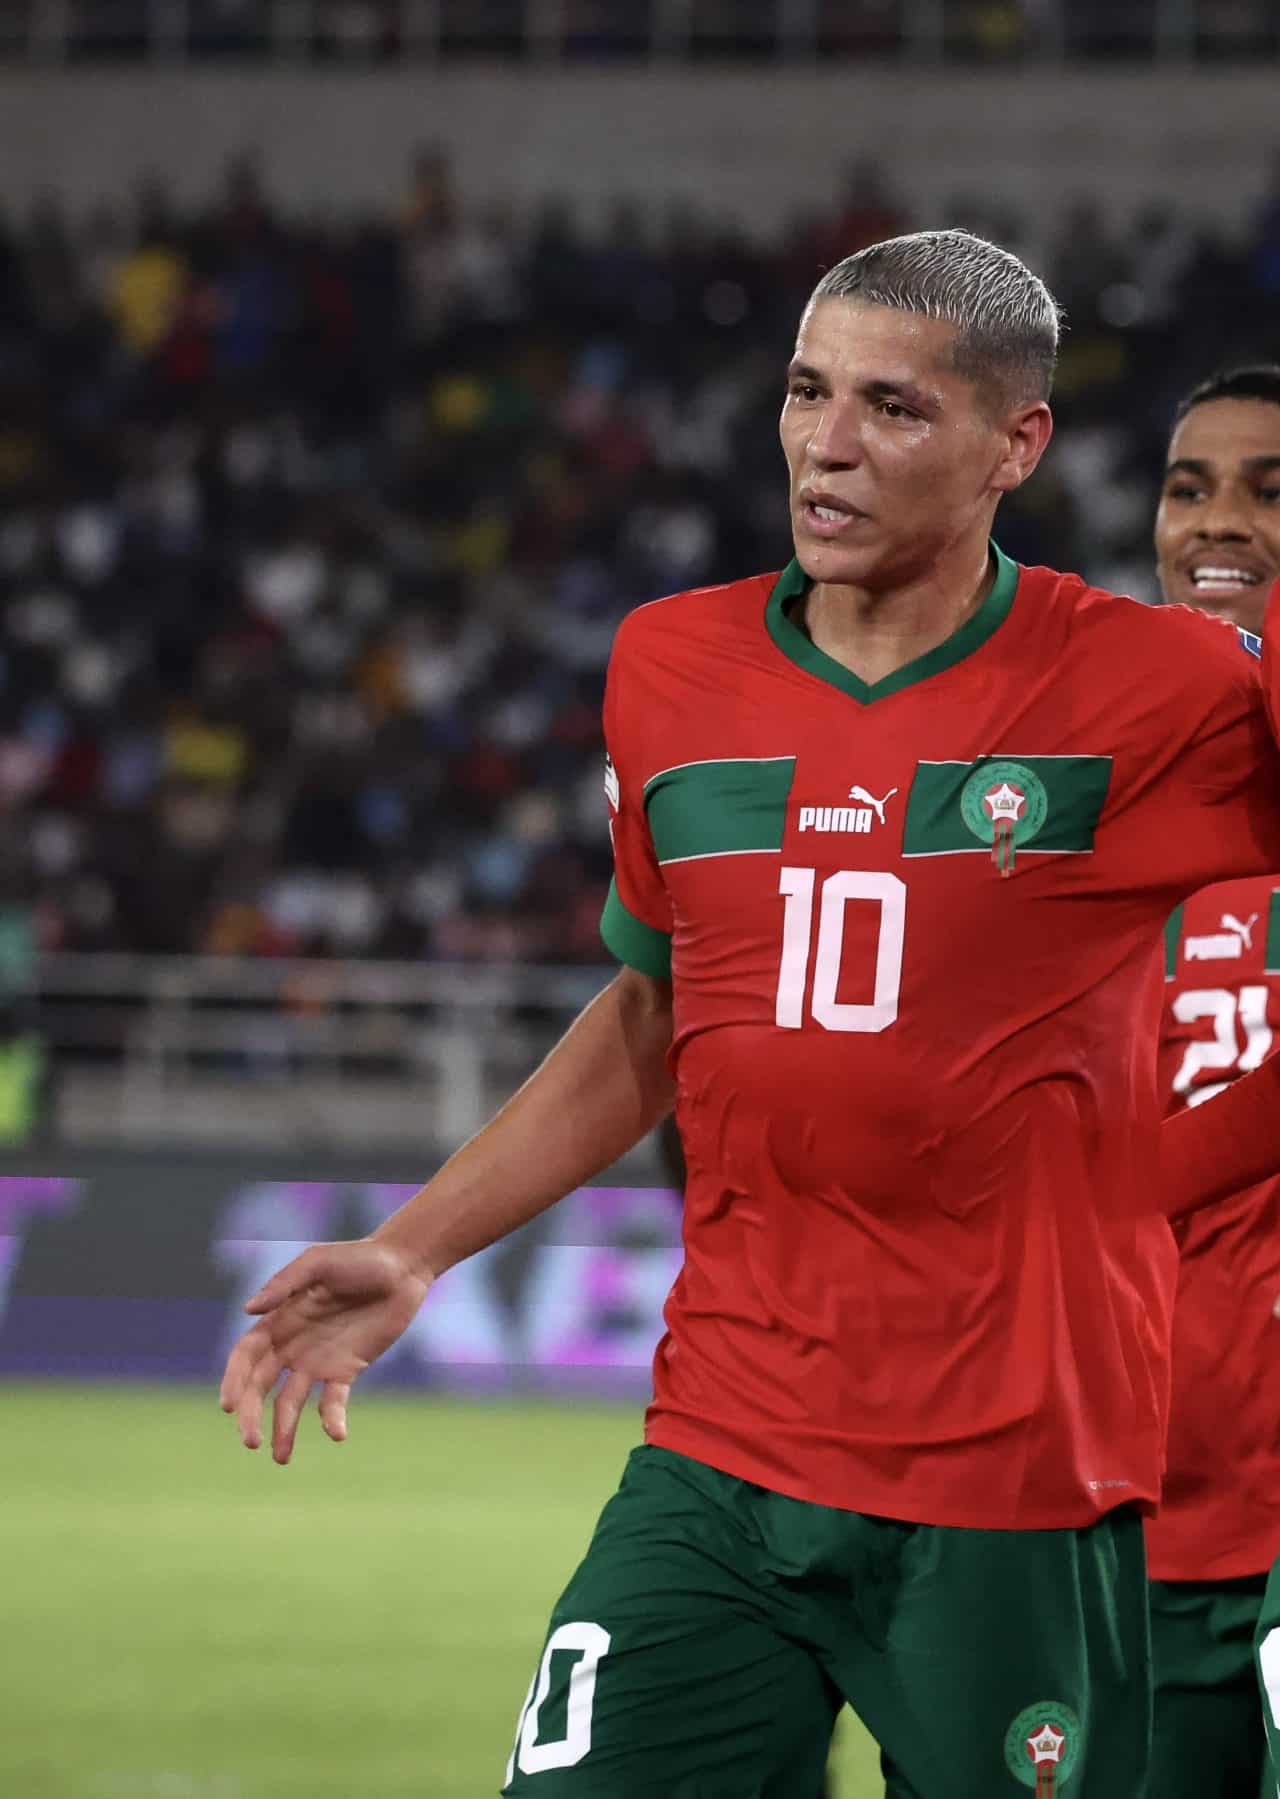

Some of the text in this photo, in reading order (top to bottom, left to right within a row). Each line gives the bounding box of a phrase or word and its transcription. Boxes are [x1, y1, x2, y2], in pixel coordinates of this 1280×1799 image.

[798, 807, 872, 833] PUMA
[775, 866, 907, 1032] 10
[1172, 985, 1272, 1108] 21
[504, 1621, 611, 1789] 0
